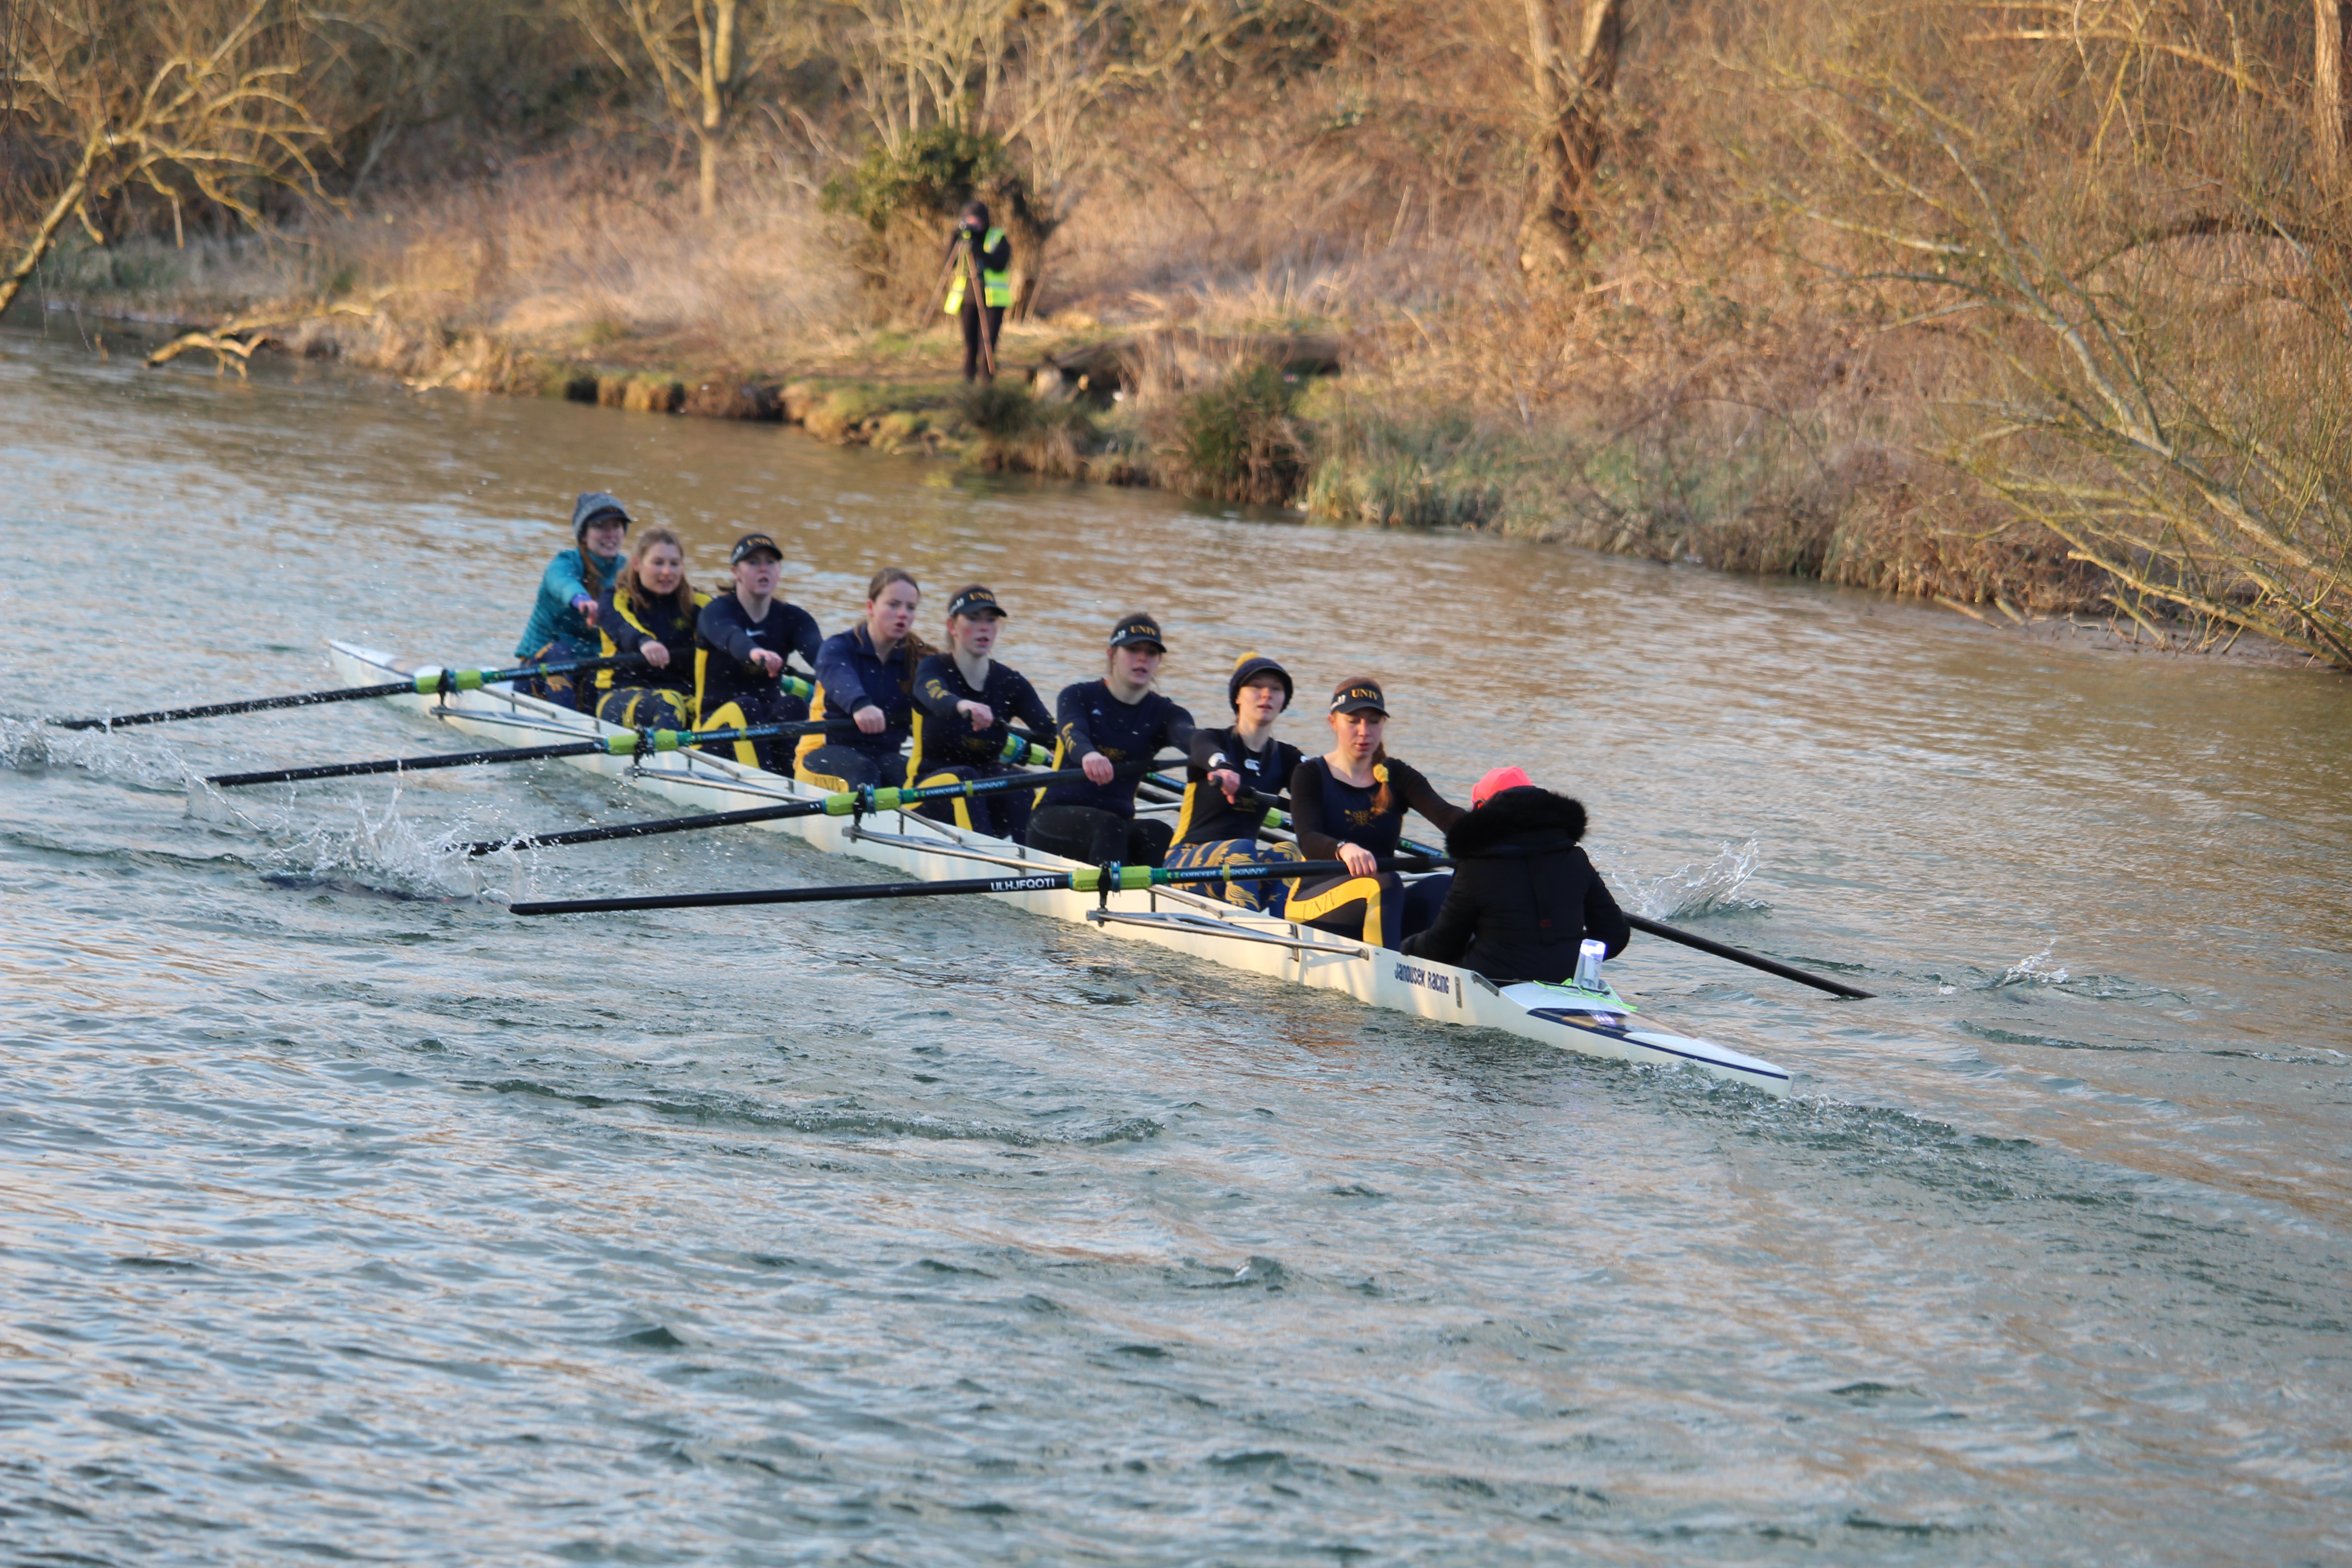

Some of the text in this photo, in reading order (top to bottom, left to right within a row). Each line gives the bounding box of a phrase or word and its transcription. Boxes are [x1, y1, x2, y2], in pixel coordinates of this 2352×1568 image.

[1130, 625, 1156, 636] UNIV
[1351, 688, 1379, 700] UNIV
[1303, 889, 1339, 921] UNIV
